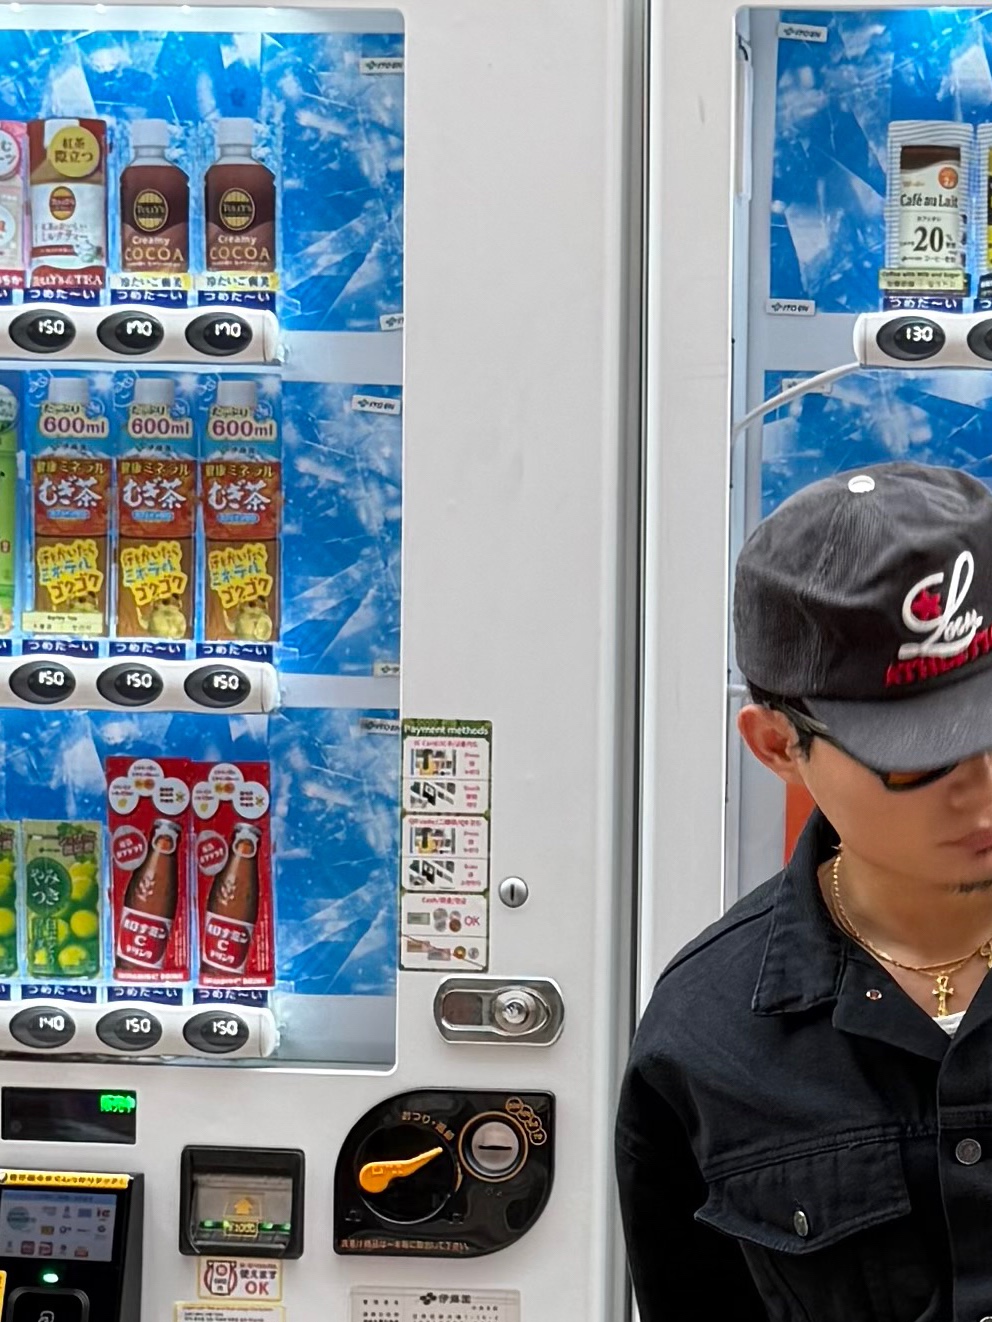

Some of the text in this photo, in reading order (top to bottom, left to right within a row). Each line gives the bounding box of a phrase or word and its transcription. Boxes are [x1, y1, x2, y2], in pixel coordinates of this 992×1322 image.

[63, 138, 86, 149] 紅茶
[900, 193, 958, 208] Café au Lait
[132, 235, 170, 247] Creamy
[218, 234, 257, 246] Creamy
[913, 226, 944, 253] 20
[125, 247, 184, 262] COCOA
[209, 247, 270, 261] COCOA
[39, 320, 65, 334] 150
[906, 327, 933, 341] 130
[43, 418, 105, 434] 600ml
[131, 418, 190, 436] 600ml
[212, 420, 273, 437] 600ml
[38, 476, 103, 507] むぎ茶
[122, 477, 187, 509] むぎ茶
[207, 479, 271, 511] むぎ茶
[51, 575, 99, 599] ゴクゴク
[135, 576, 183, 600] ゴクゴク
[222, 578, 270, 602] ゴクゴク
[39, 671, 65, 685] 150
[126, 672, 152, 688] 150
[213, 674, 239, 689] 150
[404, 726, 489, 735] Payment methods
[464, 915, 481, 926] OK
[134, 935, 147, 946] C
[217, 940, 229, 951] C
[39, 1016, 65, 1030] 140
[126, 1018, 151, 1033] 150
[213, 1020, 238, 1035] 150
[245, 1282, 269, 1295] OK
